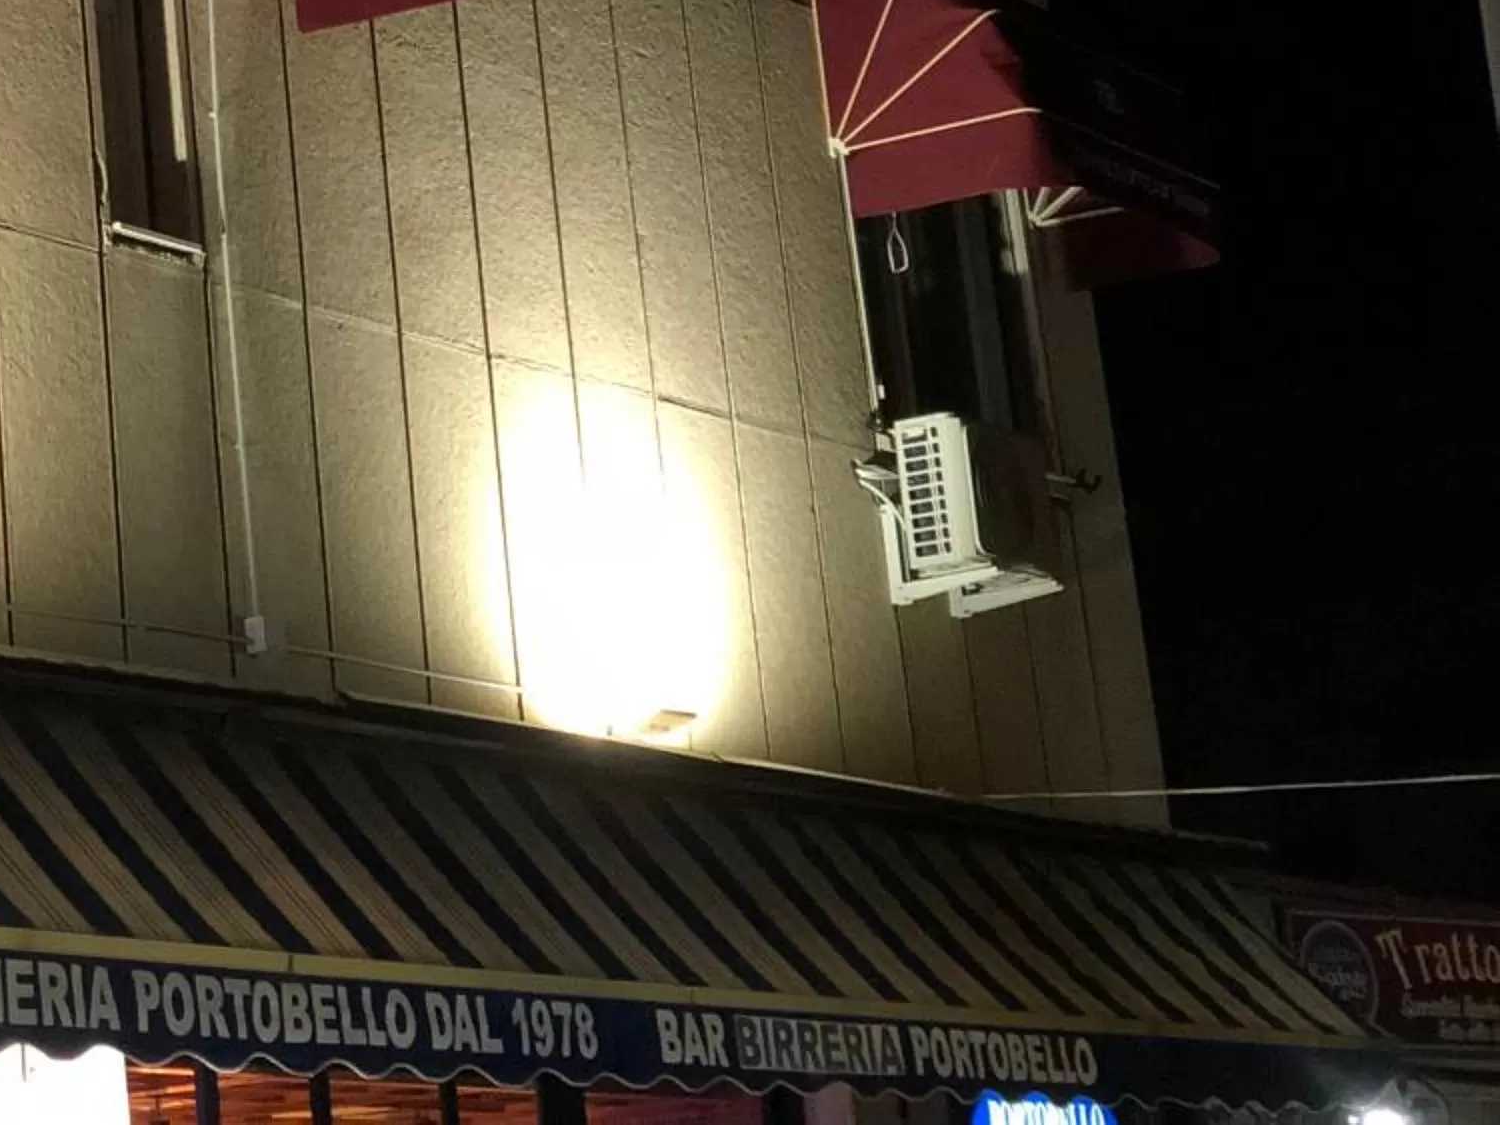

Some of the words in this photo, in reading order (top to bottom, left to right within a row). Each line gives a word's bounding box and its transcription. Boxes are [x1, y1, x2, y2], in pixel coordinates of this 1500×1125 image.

[131, 969, 417, 1050] PORTOBELLO
[425, 990, 505, 1055] DAL
[511, 997, 600, 1060] 1978
[656, 1008, 730, 1069] BAR
[734, 1014, 905, 1075] BIRRERIA
[907, 1023, 1100, 1087] PORTOBELLO
